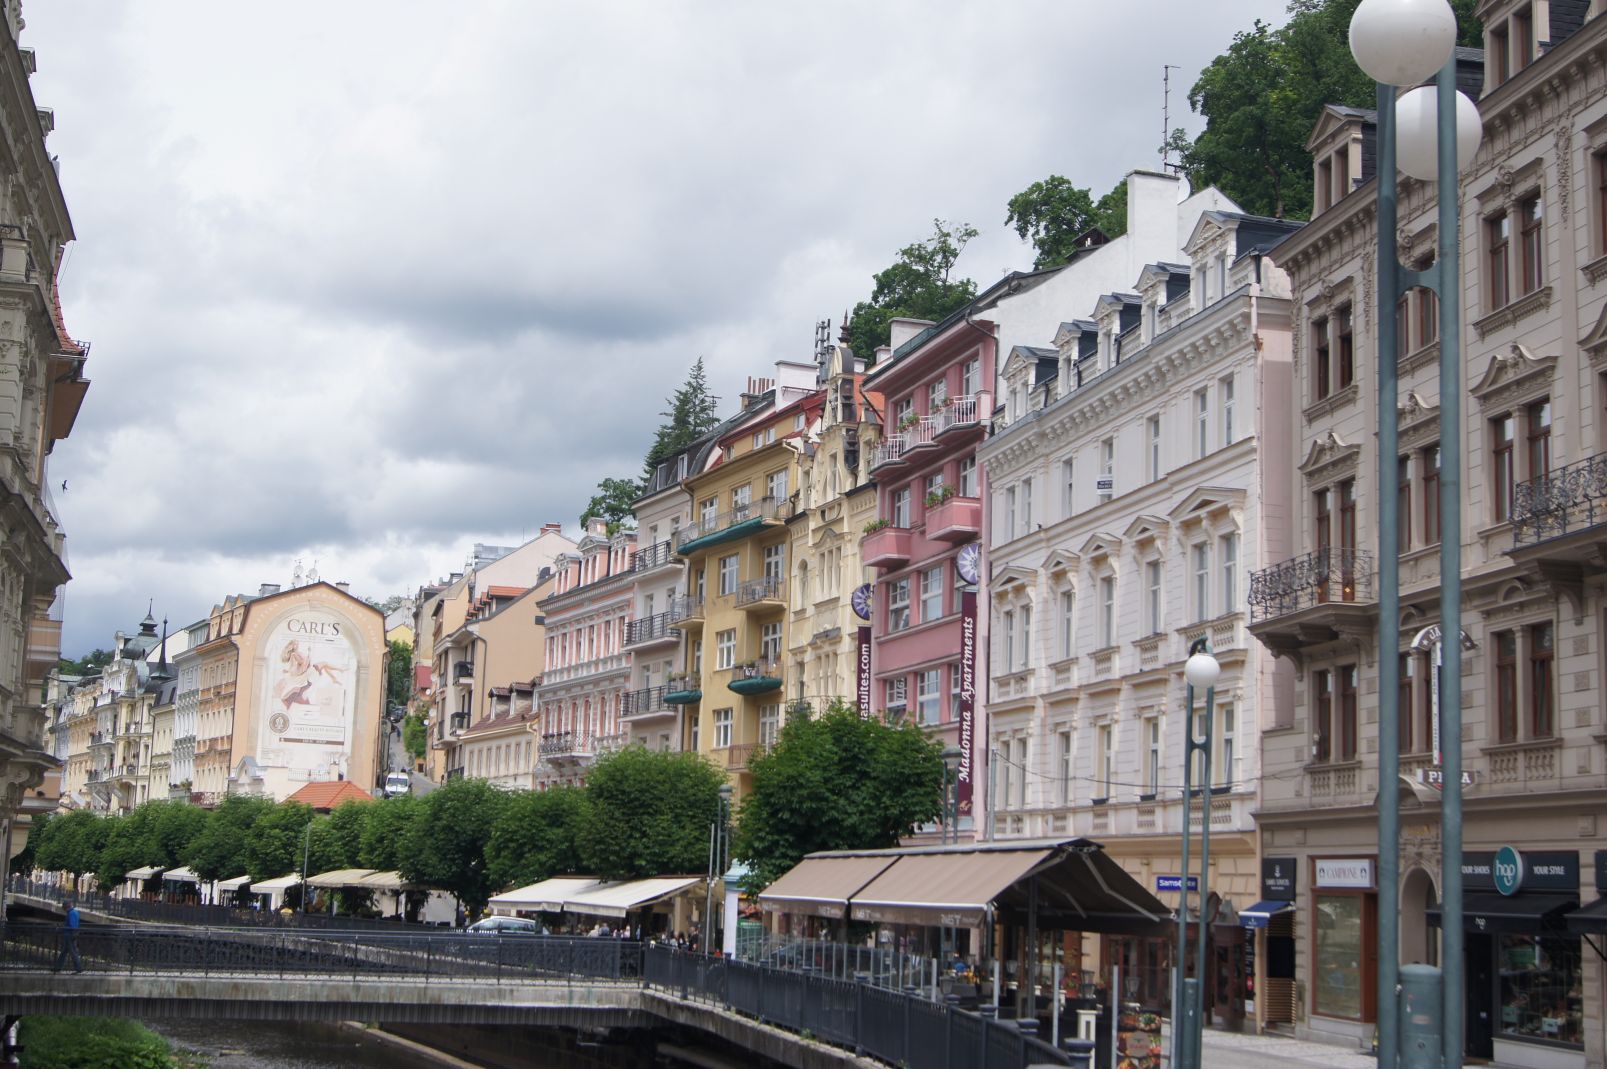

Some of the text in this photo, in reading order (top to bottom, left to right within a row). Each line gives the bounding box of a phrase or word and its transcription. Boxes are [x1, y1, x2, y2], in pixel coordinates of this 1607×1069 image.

[287, 618, 341, 636] CARL'S
[958, 616, 975, 783] Madonna Apartments
[1428, 771, 1471, 783] PIA
[1533, 865, 1565, 875] YOUR STYLE
